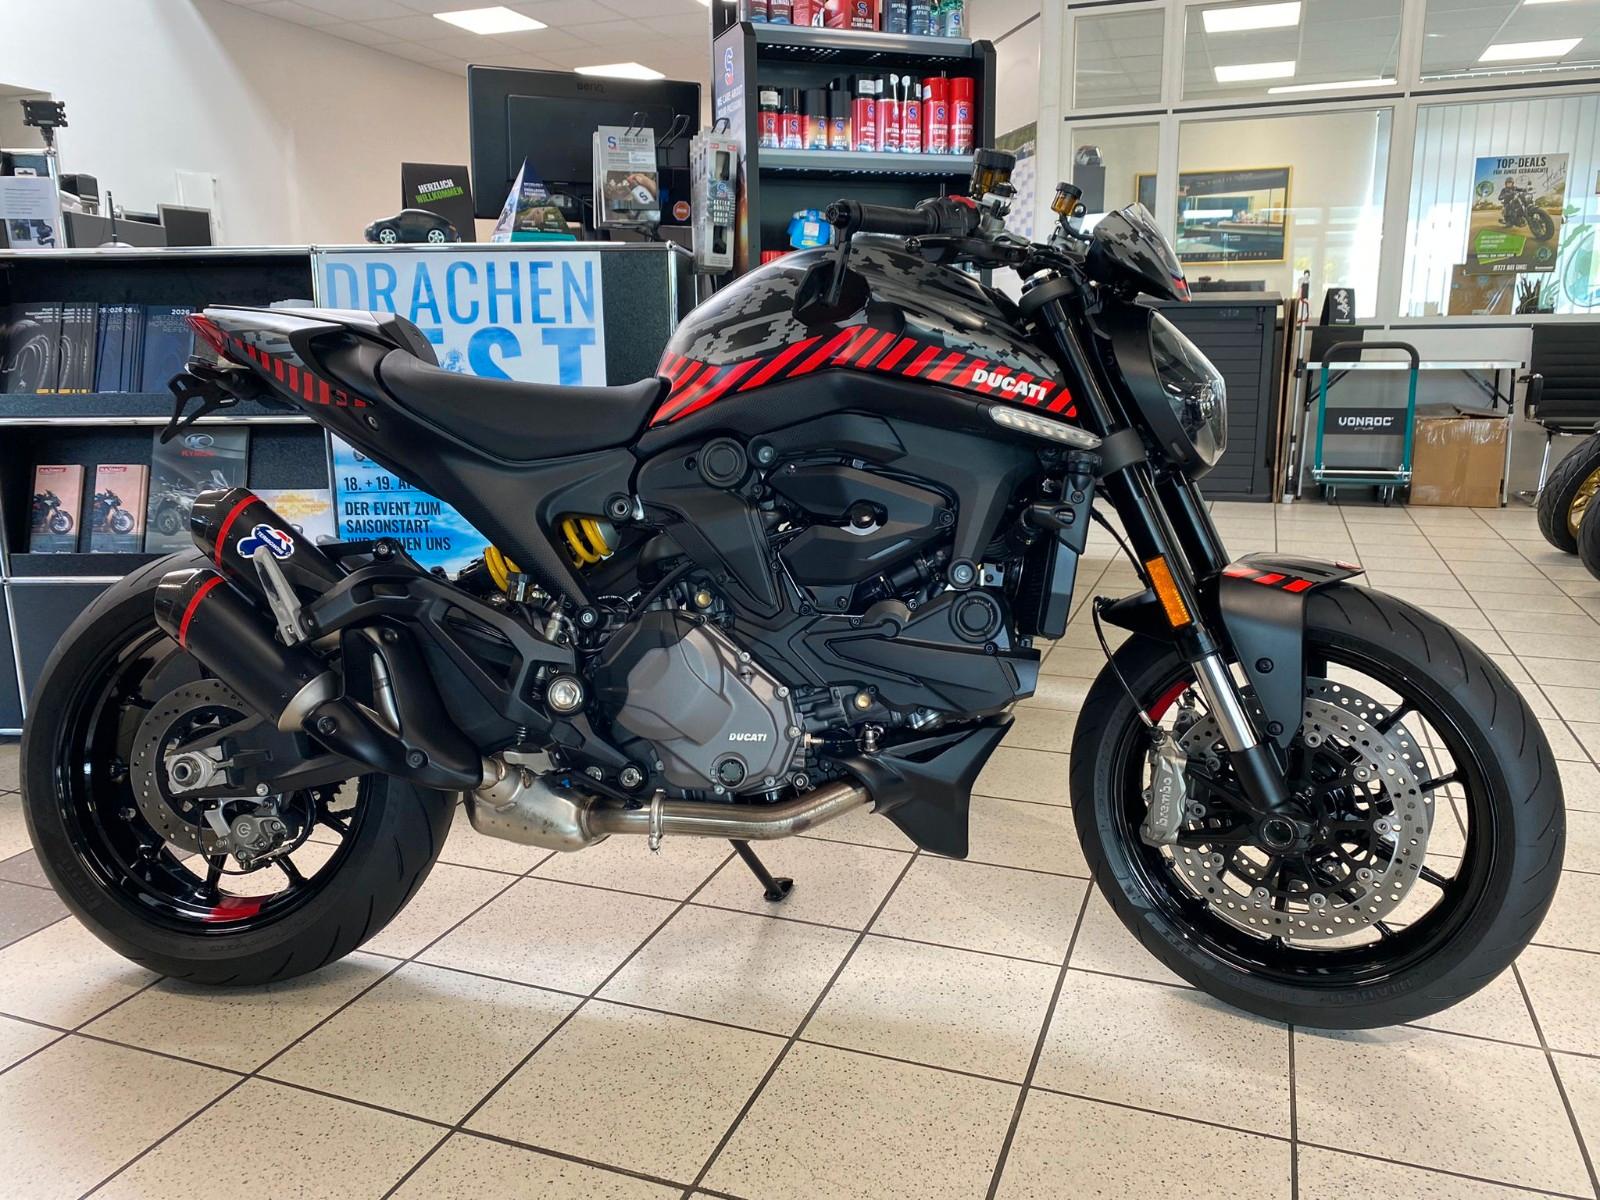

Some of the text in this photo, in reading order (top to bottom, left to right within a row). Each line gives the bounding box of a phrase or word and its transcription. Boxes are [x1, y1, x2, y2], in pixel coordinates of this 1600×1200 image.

[1497, 157, 1547, 168] TOP-DEALS
[418, 179, 454, 194] HERZLICH
[416, 186, 464, 203] WILLKOMMEN
[325, 261, 595, 325] DRACHEN
[971, 368, 1047, 401] DUCATI
[1338, 416, 1393, 426] VONROC
[344, 477, 362, 491] 18.
[376, 476, 394, 491] 19.
[345, 502, 441, 516] DER EVENT ZUM
[346, 519, 433, 534] SAISONSTART.
[426, 537, 451, 551] UNS
[728, 732, 767, 742] DUCATI
[1156, 777, 1172, 828] brembo
